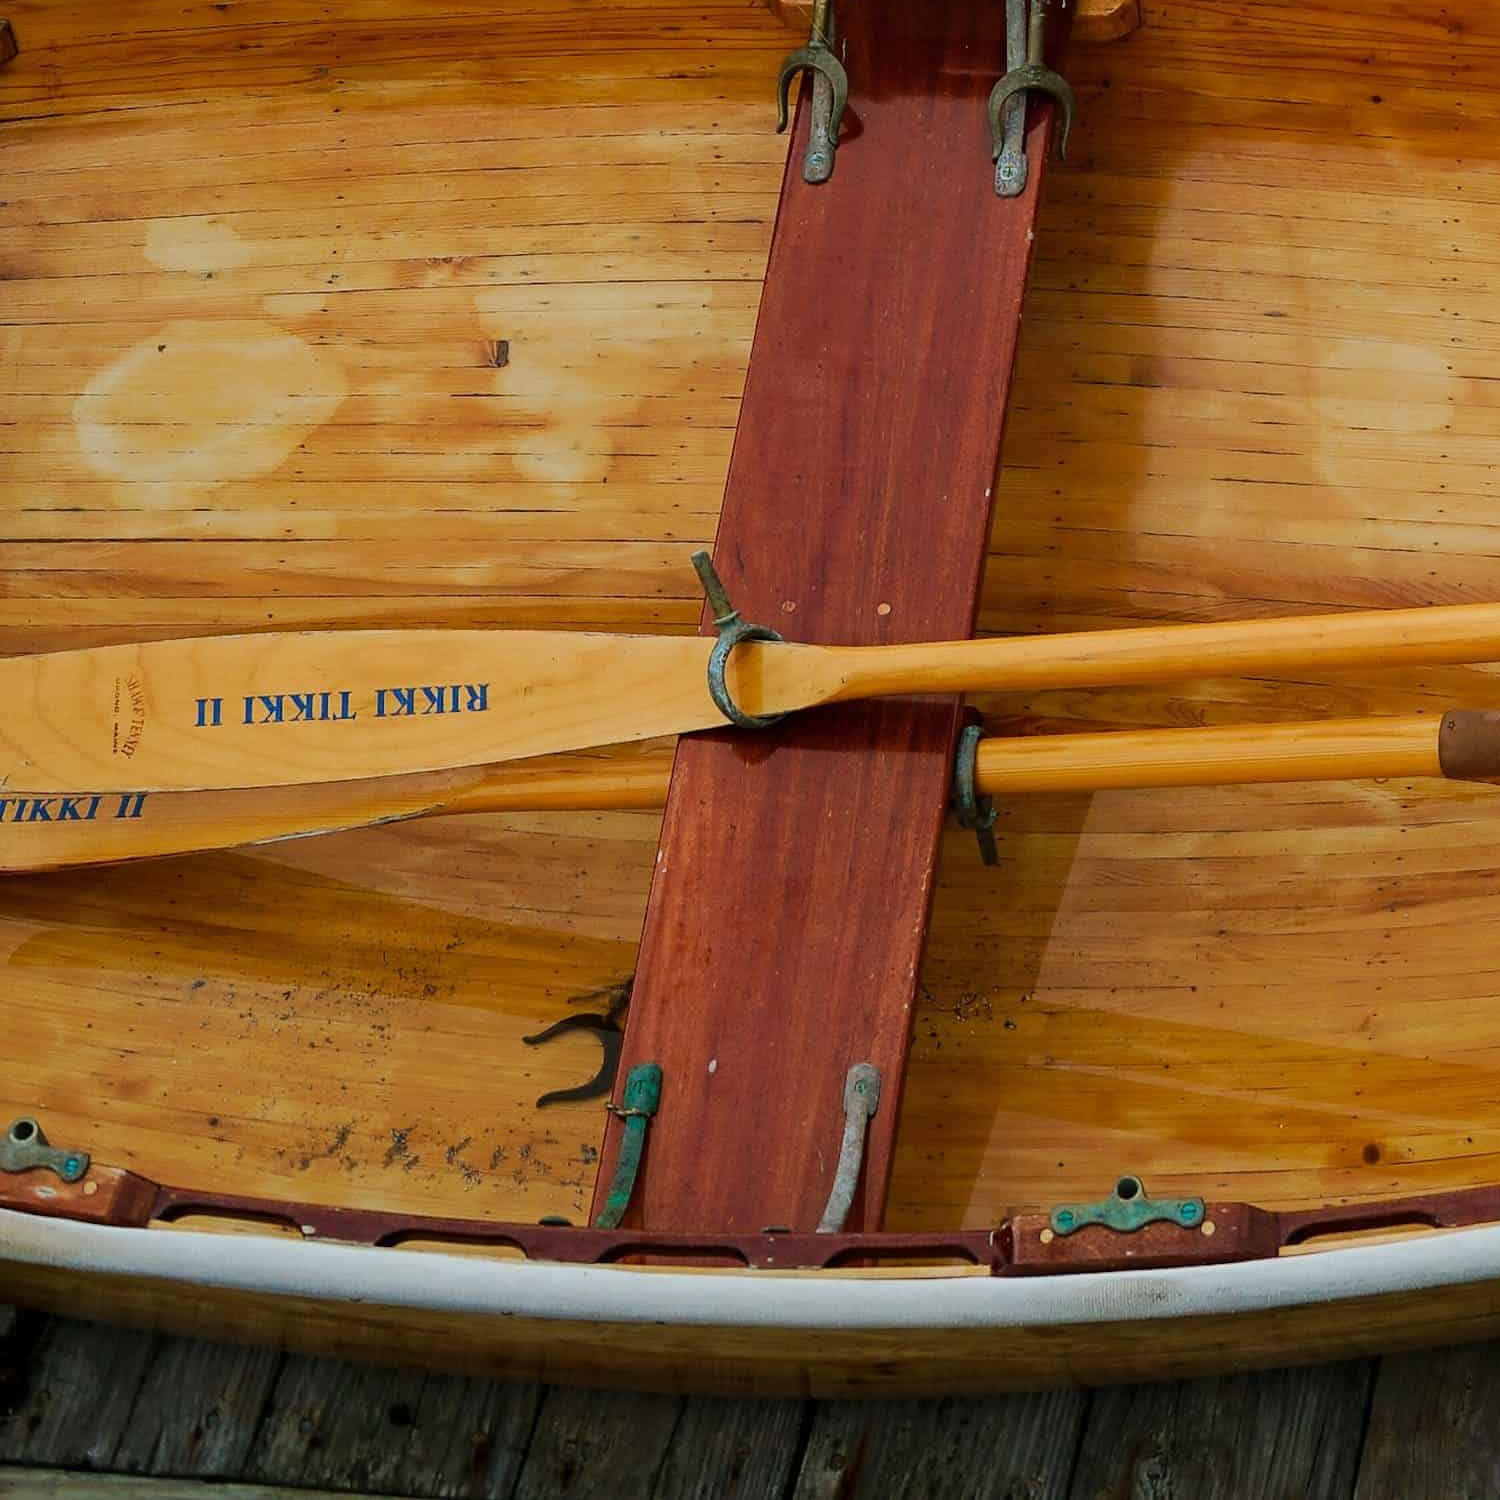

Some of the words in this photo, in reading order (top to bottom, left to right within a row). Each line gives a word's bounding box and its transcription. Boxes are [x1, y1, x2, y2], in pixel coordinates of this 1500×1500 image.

[193, 697, 224, 728] II
[242, 690, 358, 725] TIKKI
[374, 683, 490, 718] RIKKI
[114, 792, 149, 818] II
